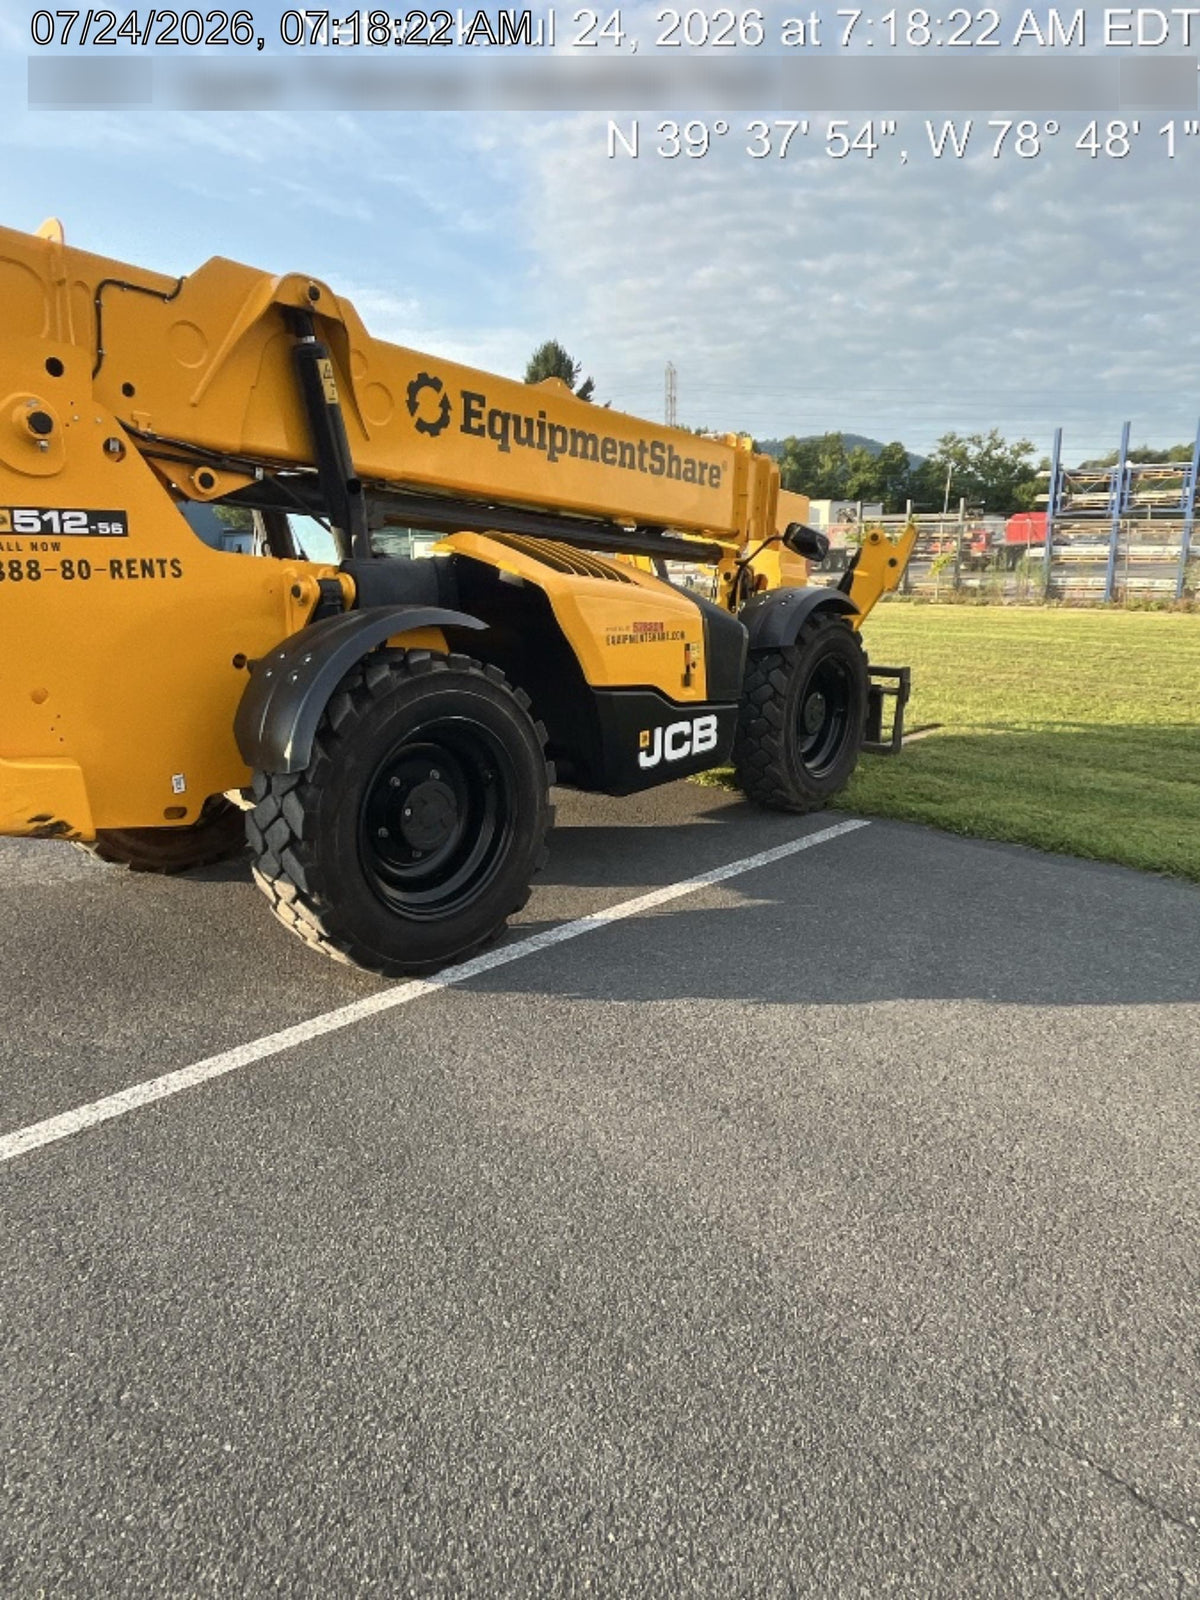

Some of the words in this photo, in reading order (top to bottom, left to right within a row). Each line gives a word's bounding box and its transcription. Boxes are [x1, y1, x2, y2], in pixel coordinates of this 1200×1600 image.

[459, 389, 721, 489] EquipmentShare
[13, 509, 124, 535] 512-56
[30, 541, 61, 552] NOW
[638, 714, 718, 769] JCB
